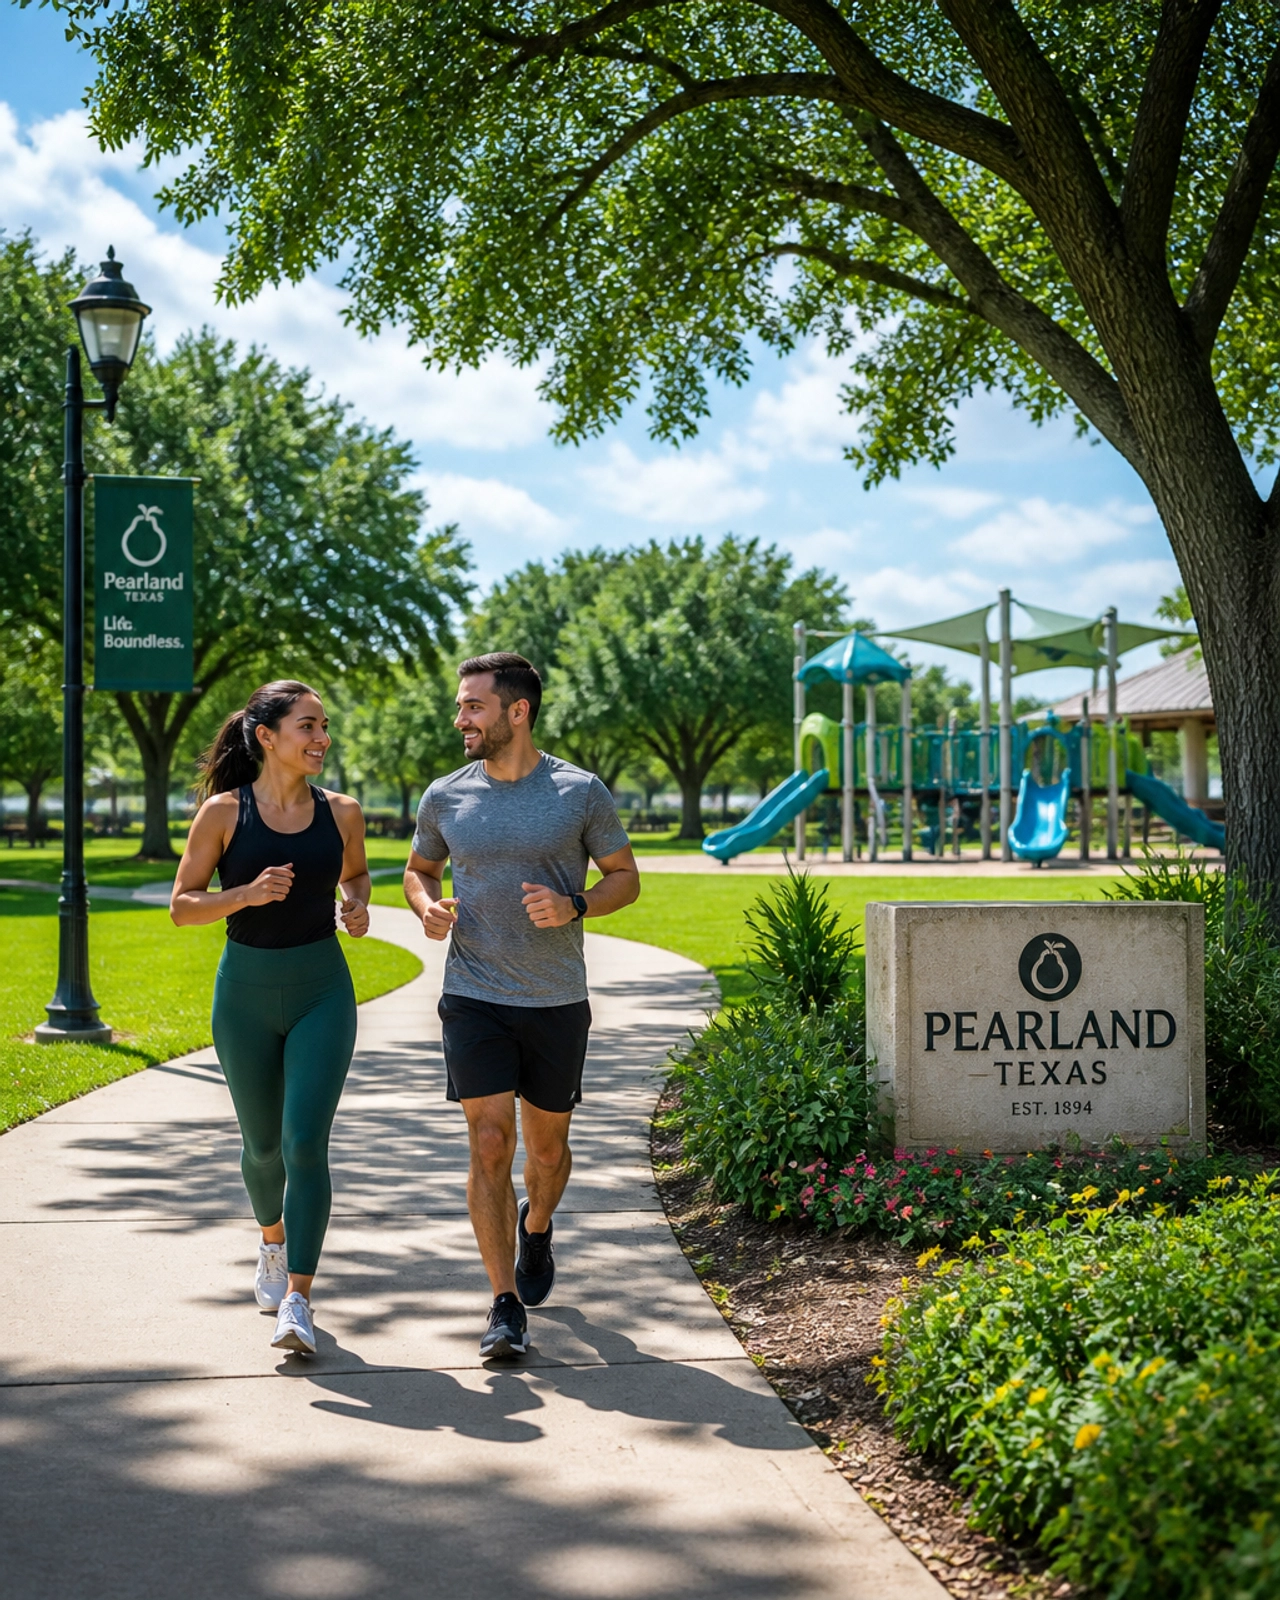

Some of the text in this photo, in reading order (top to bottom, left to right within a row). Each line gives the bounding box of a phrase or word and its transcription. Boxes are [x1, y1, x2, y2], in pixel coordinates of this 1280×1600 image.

[104, 572, 184, 590] Pearland
[124, 592, 164, 602] TEXAS
[104, 633, 185, 649] Boundless.
[924, 1009, 1177, 1052] PEARLAND
[993, 1060, 1107, 1086] TEXAS
[1011, 1100, 1093, 1116] EST. 1894
